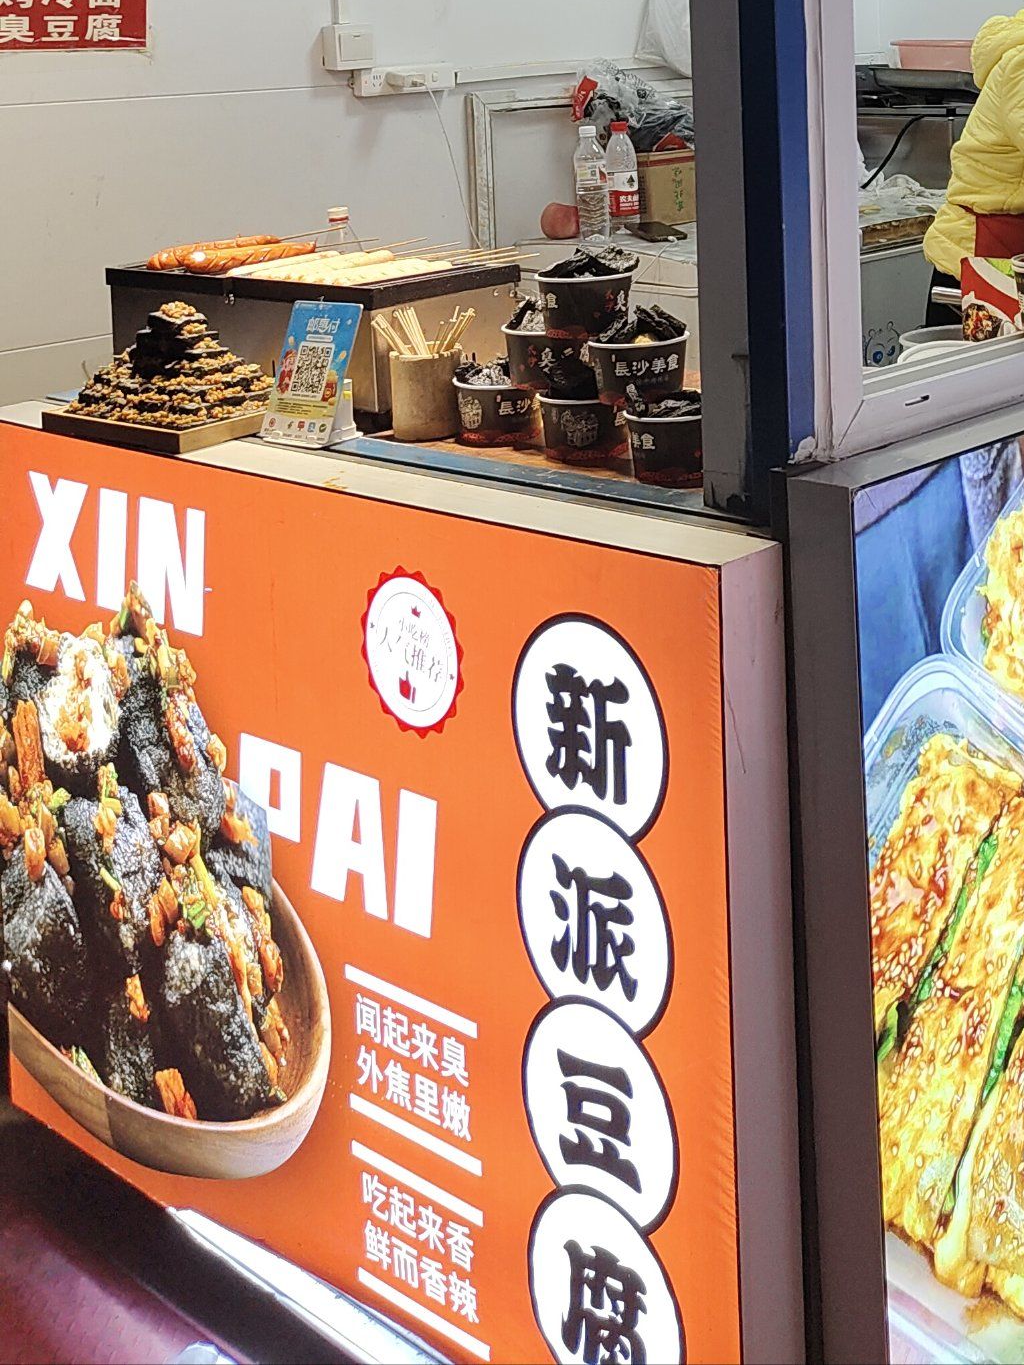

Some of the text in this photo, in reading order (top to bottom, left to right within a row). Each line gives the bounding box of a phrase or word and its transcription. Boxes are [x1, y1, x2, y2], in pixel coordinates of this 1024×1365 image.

[0, 14, 122, 43] 臭豆腐
[25, 470, 206, 637] XIN
[354, 993, 469, 1087] 闻起来臭
[544, 662, 649, 1365] 新派豆腐
[357, 1045, 472, 1142] 外焦里嫩
[361, 1172, 475, 1273] 吃起来香
[364, 1220, 480, 1324] 鲜而香辣
